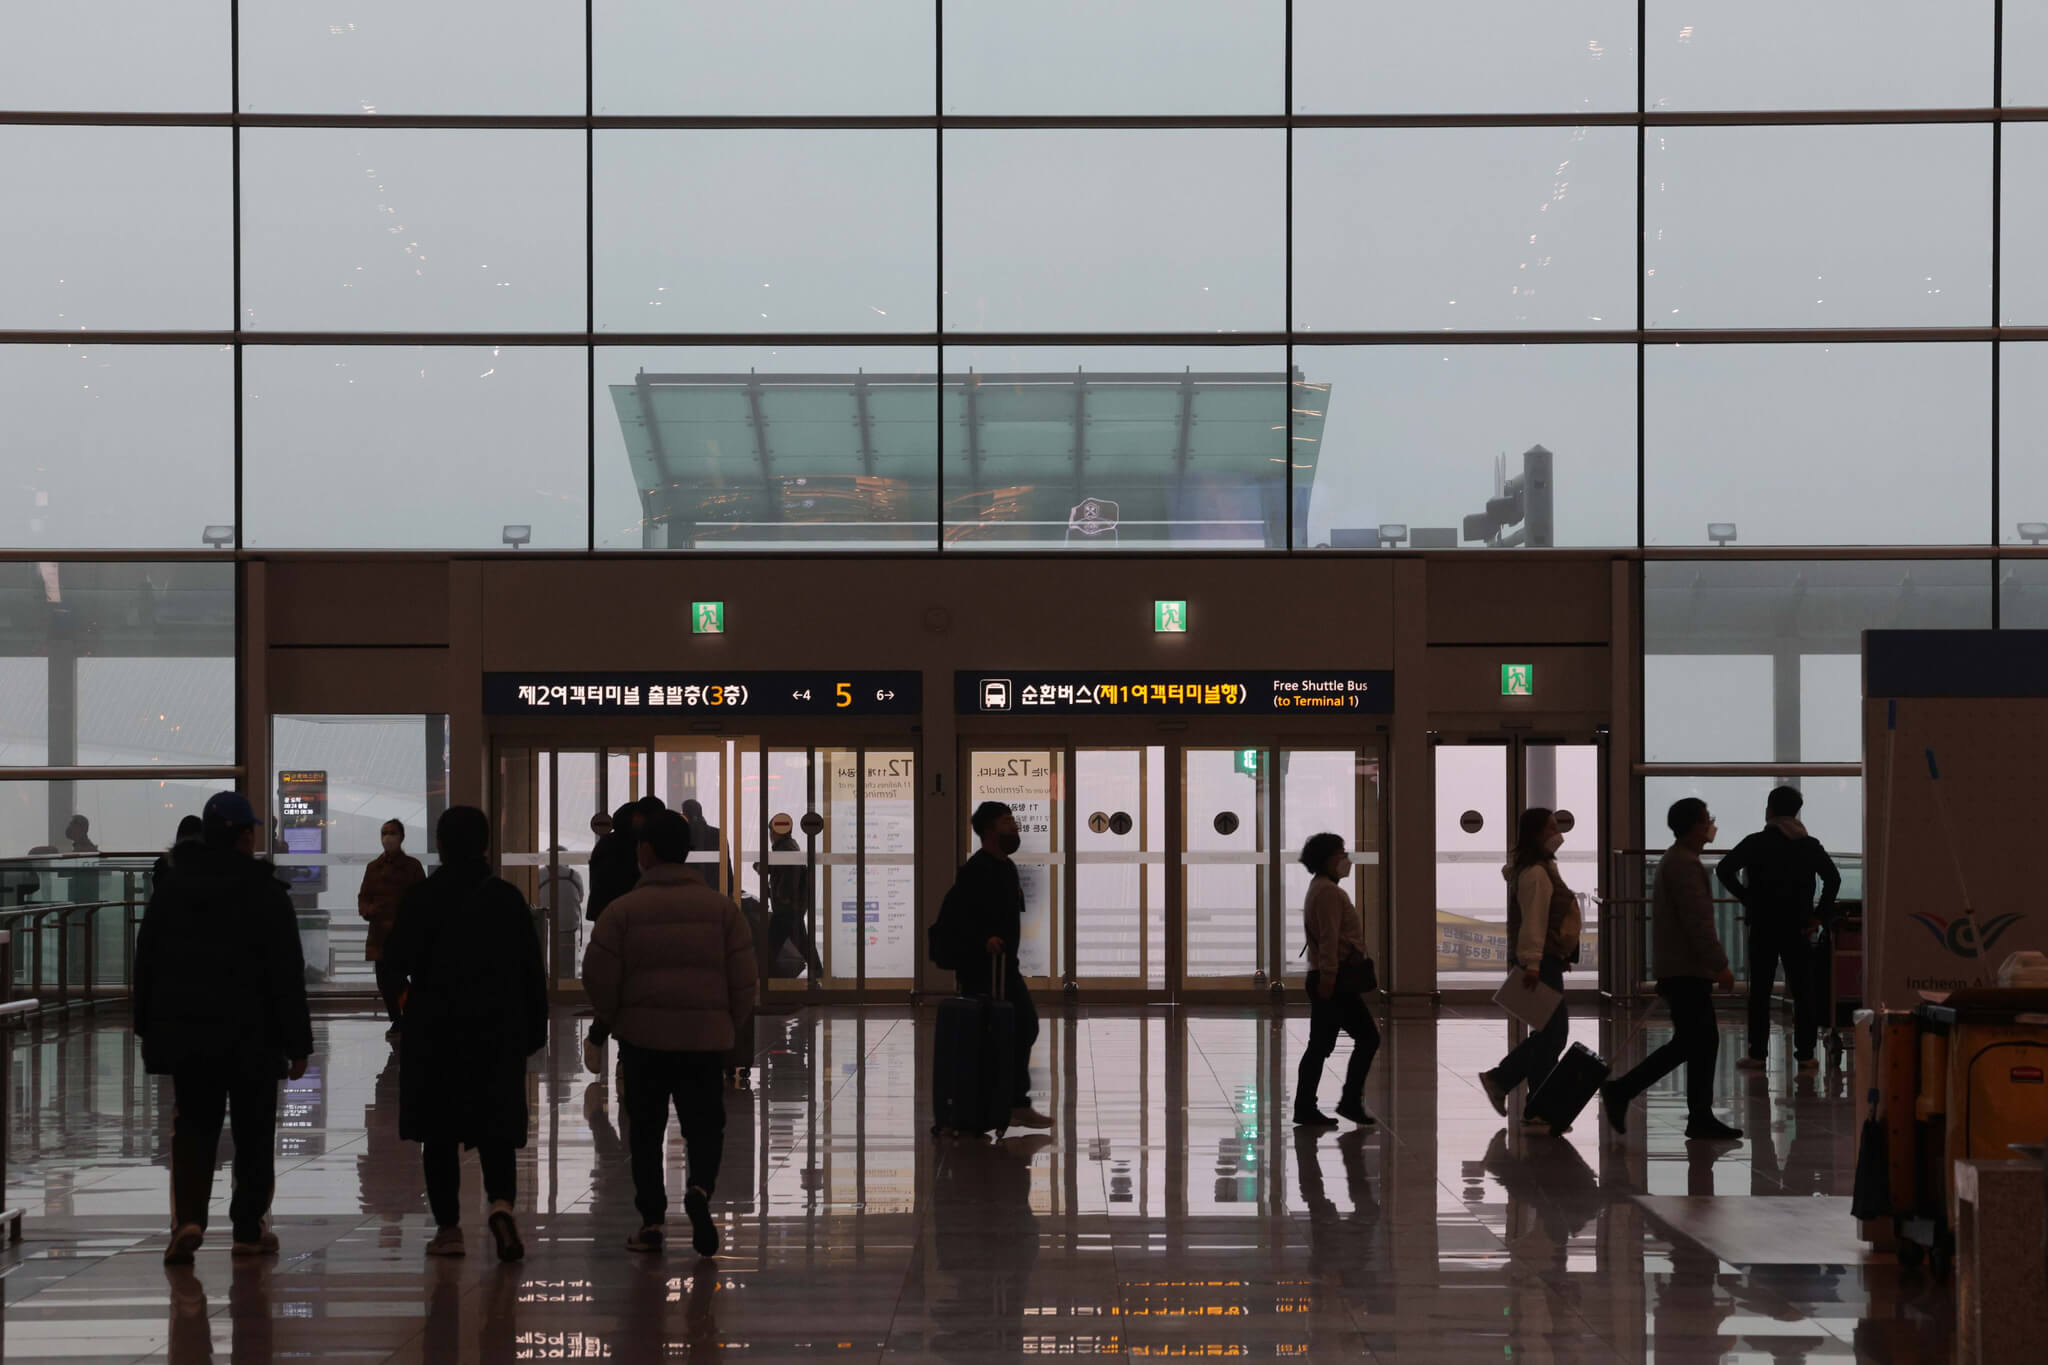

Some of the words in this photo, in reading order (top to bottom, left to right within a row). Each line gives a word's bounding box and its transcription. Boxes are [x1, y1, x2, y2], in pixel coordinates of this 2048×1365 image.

[1273, 680, 1299, 691] Free
[1302, 680, 1344, 691] Shuttle
[1347, 680, 1368, 691] Bus
[517, 685, 640, 706] 제2여객터미널
[647, 684, 749, 706] 출발층(3층)
[802, 689, 811, 701] 4
[836, 682, 852, 707] 5
[876, 689, 885, 701] 6
[1021, 683, 1247, 705] 순환버스(제1여객터미널행)
[1273, 695, 1291, 708] (to
[1293, 695, 1344, 707] Terminal
[1348, 695, 1359, 708] 1)
